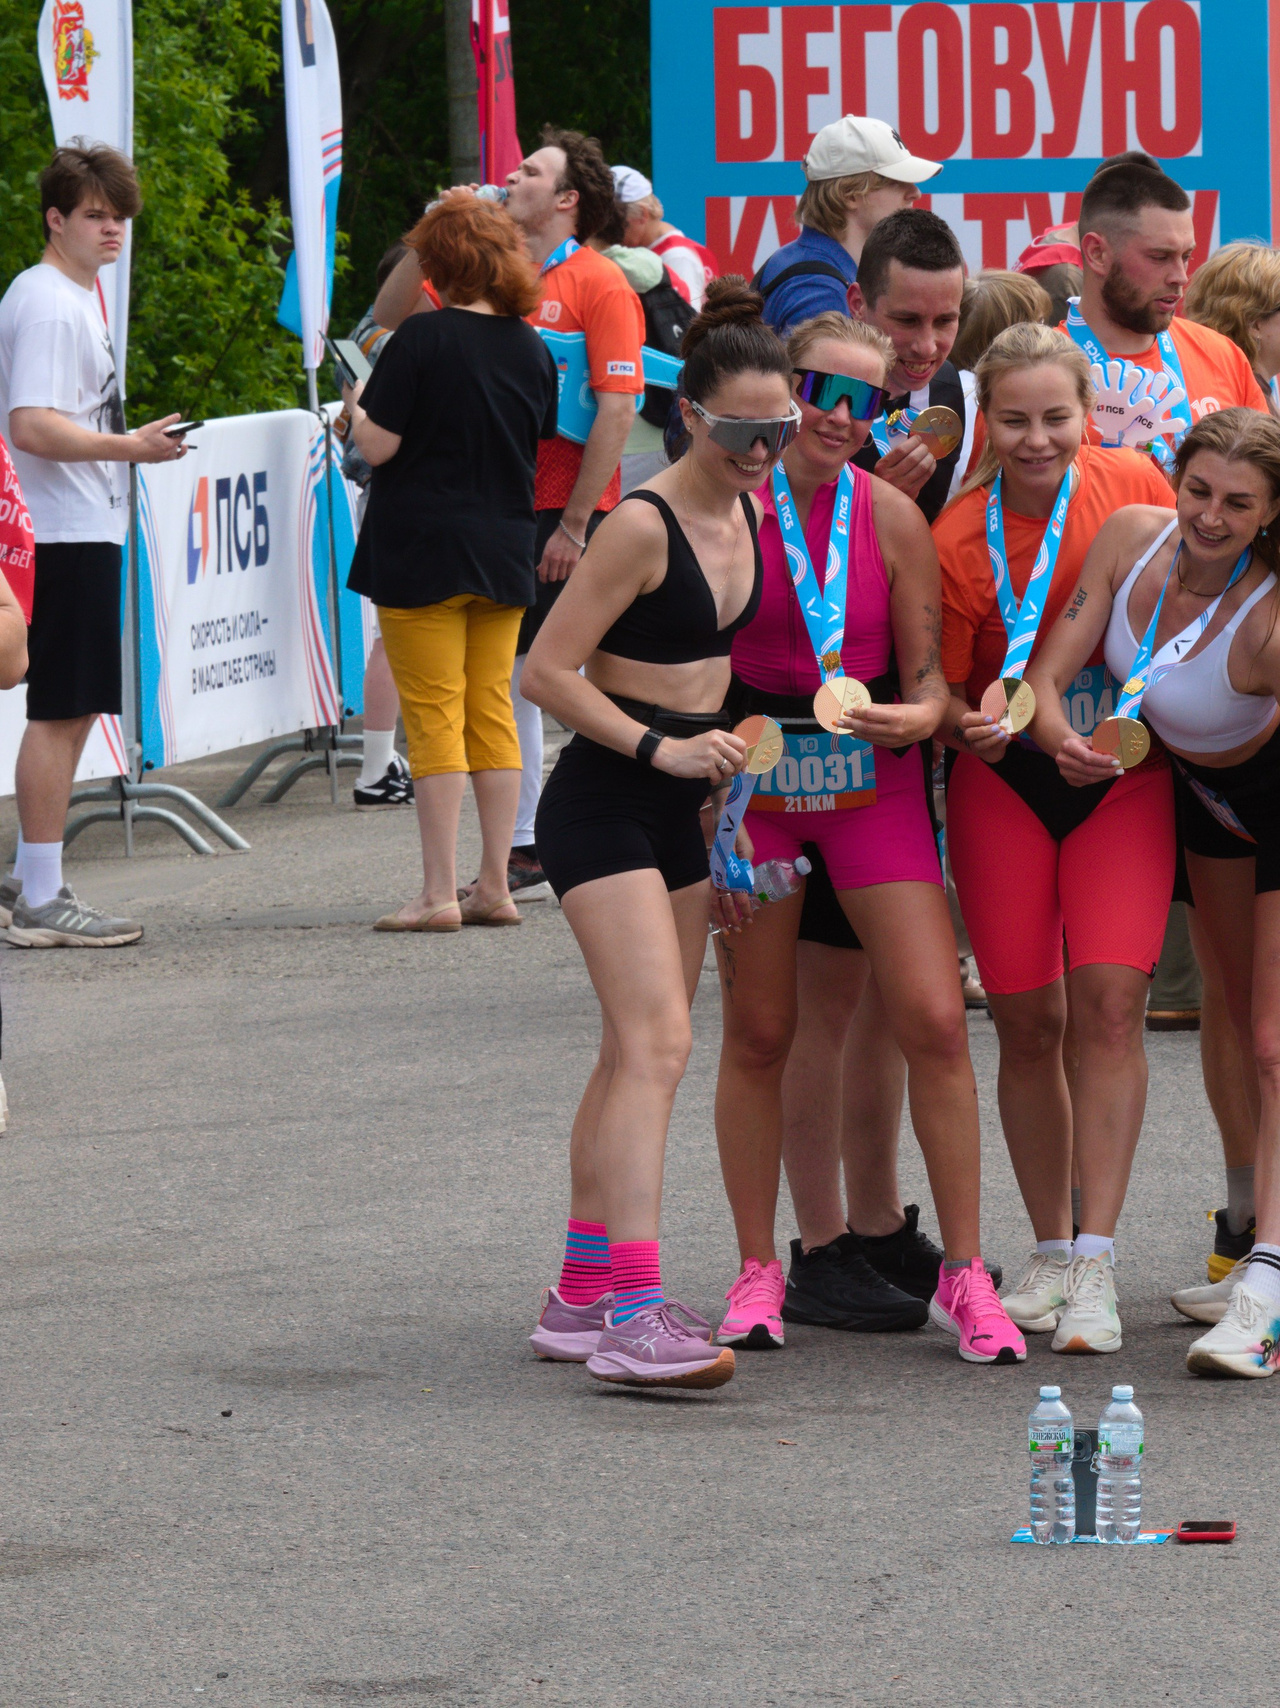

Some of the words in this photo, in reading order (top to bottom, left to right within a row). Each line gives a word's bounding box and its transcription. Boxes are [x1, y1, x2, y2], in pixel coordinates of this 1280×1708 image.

[714, 2, 1202, 163] БЕГОВУЮ
[619, 364, 634, 373] ПСБ
[1105, 405, 1125, 416] ПСБ
[781, 504, 794, 531] ПСБ
[839, 494, 849, 521] ПСБ
[989, 506, 999, 533] ПСБ
[1056, 496, 1067, 524] ПСБ
[215, 470, 270, 576] ПСБ
[1073, 586, 1088, 607] БЕГ
[191, 616, 231, 651] СКОРОСТЬ
[192, 667, 197, 695] В
[198, 657, 243, 694] МАСШТАБЕ
[243, 649, 276, 682] СТРАНЫ
[797, 737, 819, 754] 10
